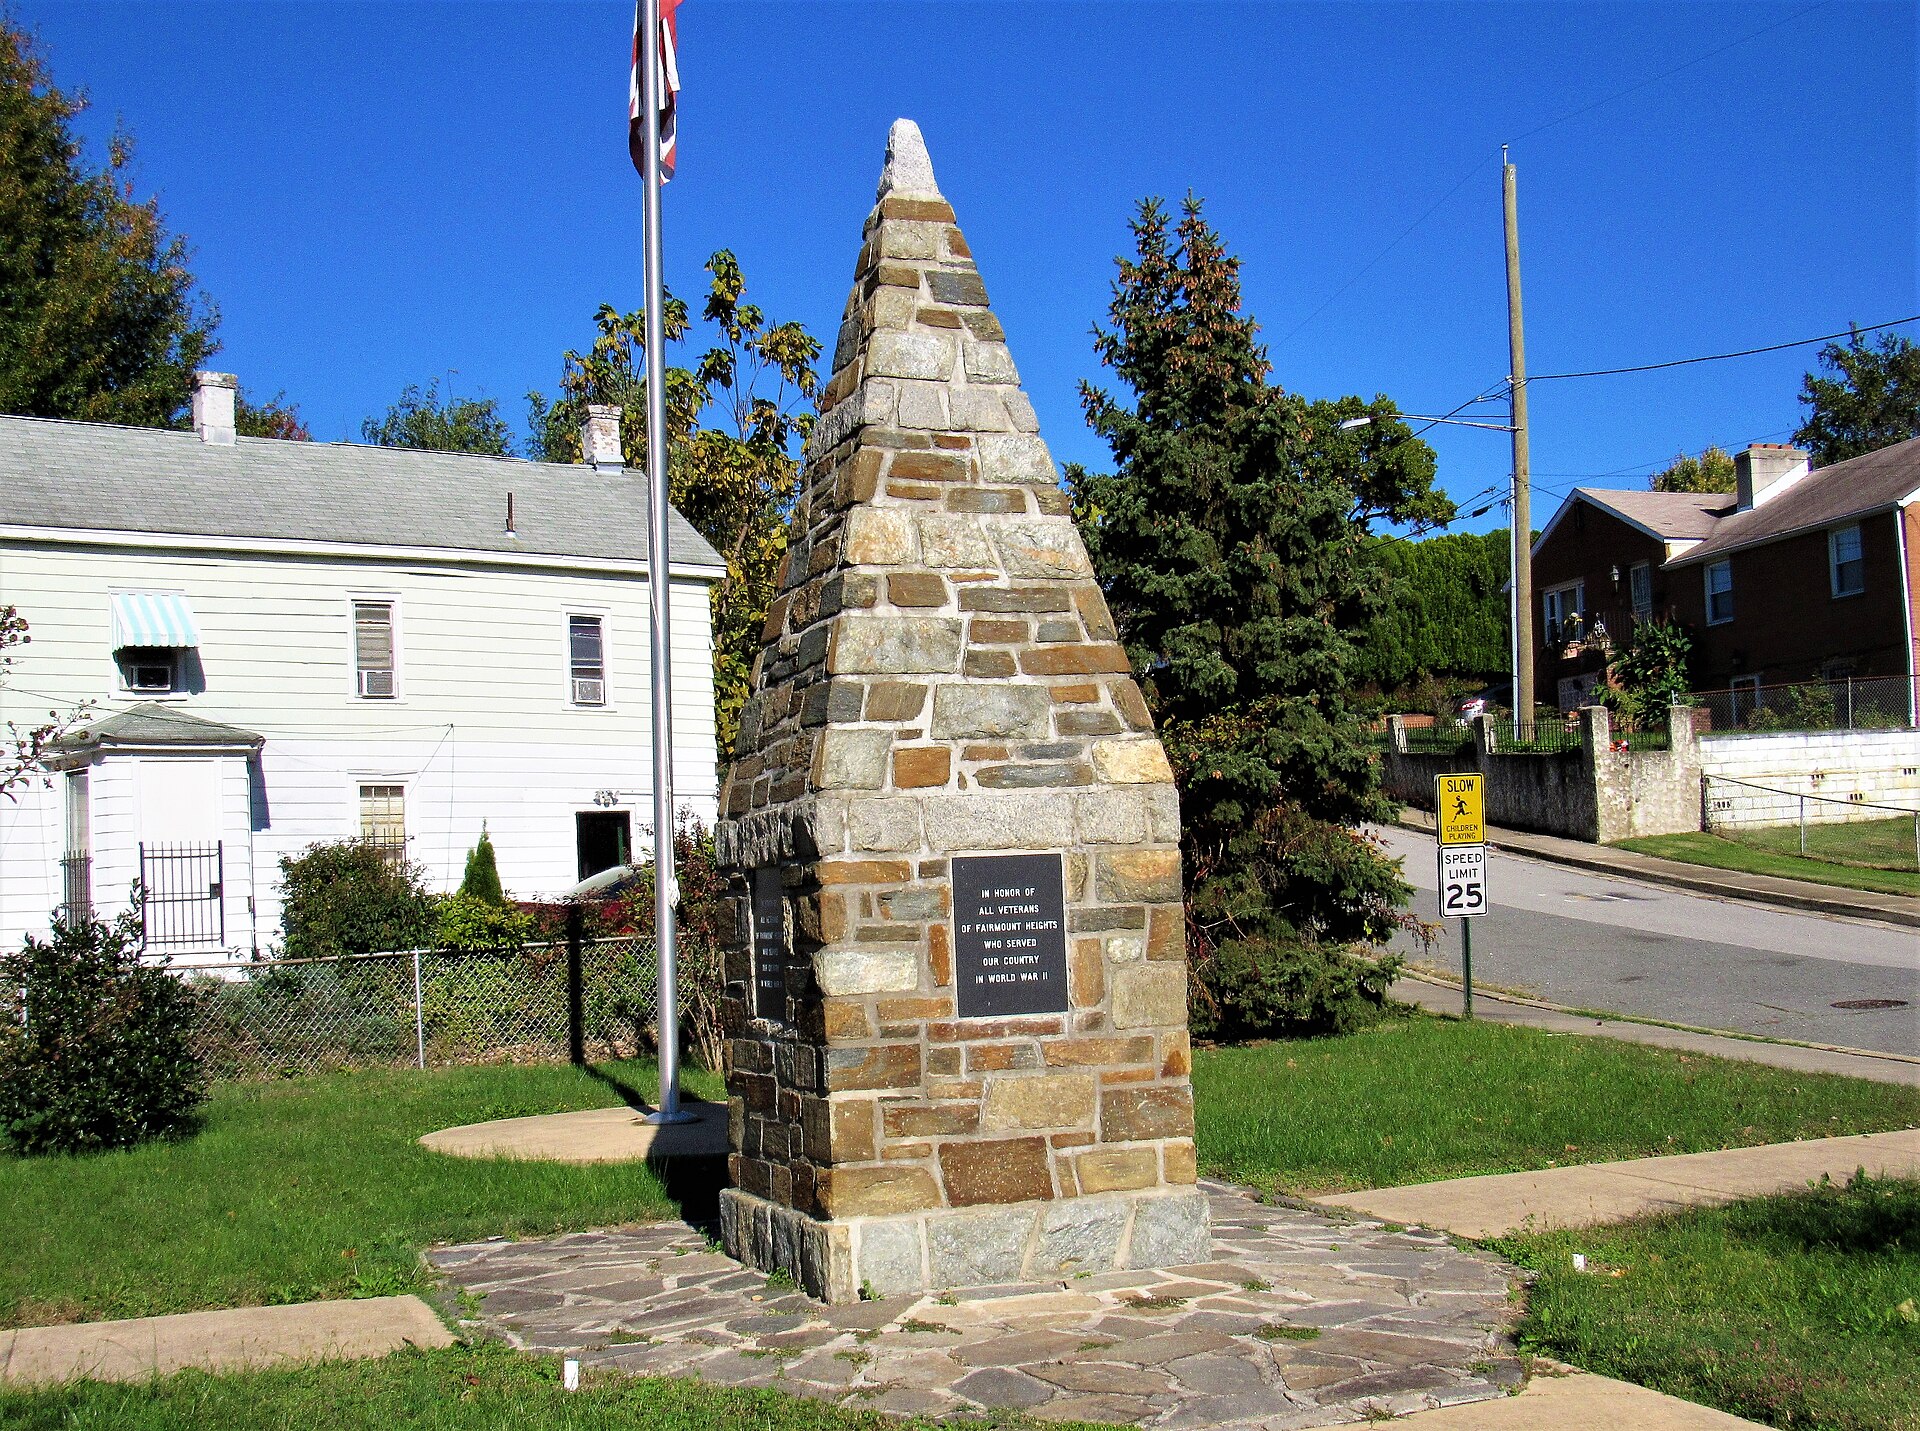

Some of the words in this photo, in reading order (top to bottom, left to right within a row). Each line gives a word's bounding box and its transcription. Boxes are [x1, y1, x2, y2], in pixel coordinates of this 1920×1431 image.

[1447, 779, 1474, 792] SLOW
[1446, 824, 1478, 833] CHILDREN
[1449, 832, 1476, 840] PLAYING
[1445, 853, 1482, 864] SPEED
[1449, 868, 1478, 879] LIMIT
[982, 890, 989, 898] IN
[995, 888, 1020, 898] HONOR
[1025, 888, 1036, 897] OF
[1446, 883, 1482, 909] 25
[979, 906, 994, 915] ALL
[998, 905, 1039, 914] VETERANS
[962, 924, 971, 933] OF
[976, 922, 1021, 932] FAIRMOUNT
[1026, 921, 1058, 930] HEIGHTS
[984, 940, 1002, 949] WHO
[1006, 939, 1037, 948] SERVED
[983, 957, 999, 966] OUR
[1004, 955, 1040, 965] COUNTRY
[975, 975, 983, 984] IN
[988, 973, 1016, 983] WORLD
[1020, 972, 1038, 981] WAR
[1043, 972, 1048, 980] II
